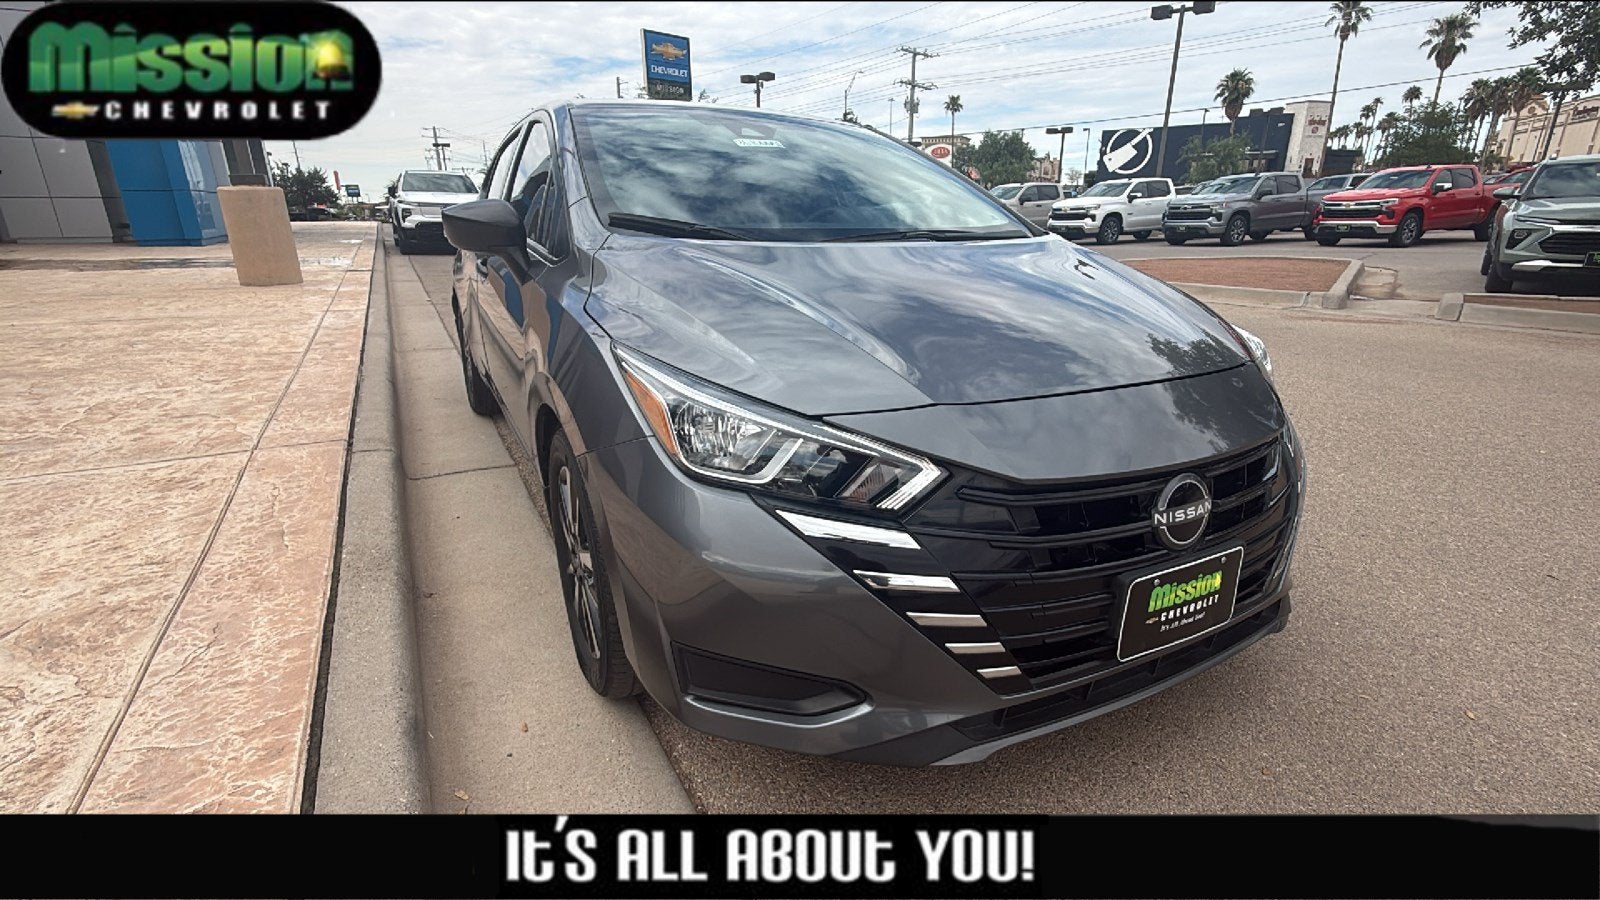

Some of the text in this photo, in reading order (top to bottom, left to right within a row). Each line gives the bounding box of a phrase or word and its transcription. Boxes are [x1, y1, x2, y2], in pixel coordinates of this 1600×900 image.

[651, 65, 688, 77] CHEVROLET
[1154, 501, 1211, 525] NISSAN
[1147, 570, 1222, 612] Mission
[1160, 594, 1219, 621] CHEVROLET
